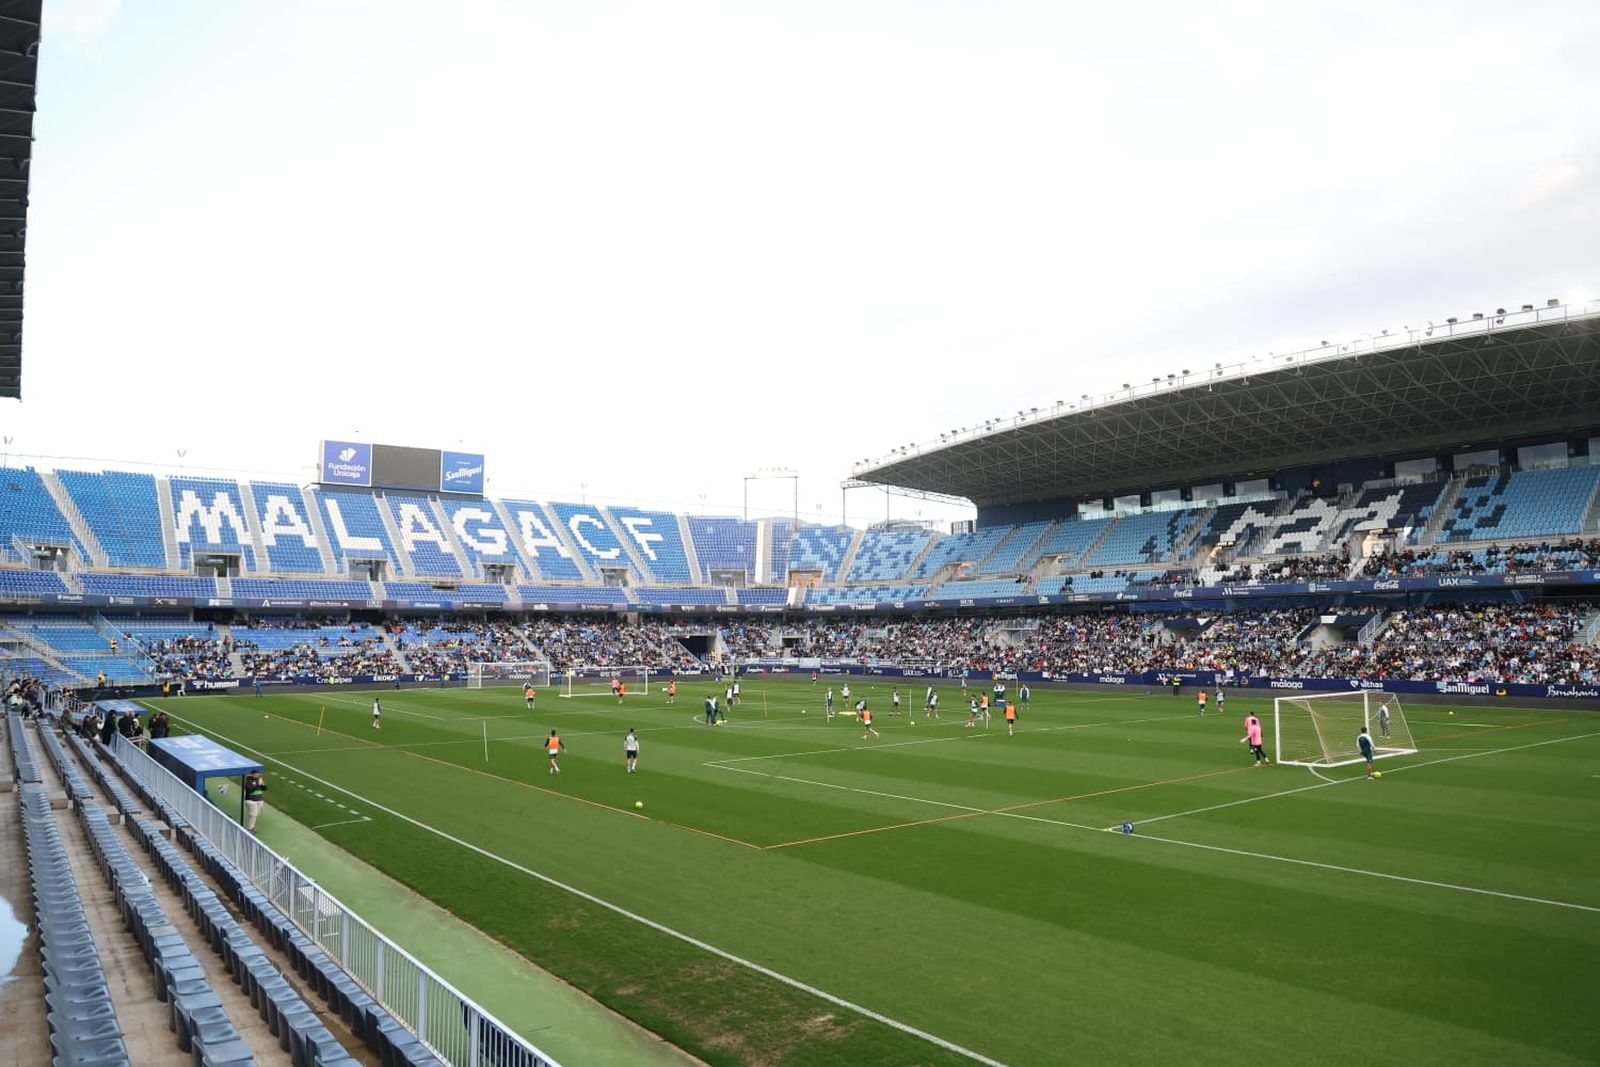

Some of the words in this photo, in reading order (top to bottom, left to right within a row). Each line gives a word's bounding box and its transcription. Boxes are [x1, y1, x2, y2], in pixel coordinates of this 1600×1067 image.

[328, 462, 367, 473] Fundación
[333, 469, 361, 479] Unicaja
[1438, 577, 1459, 587] UAX
[204, 680, 239, 689] hummel
